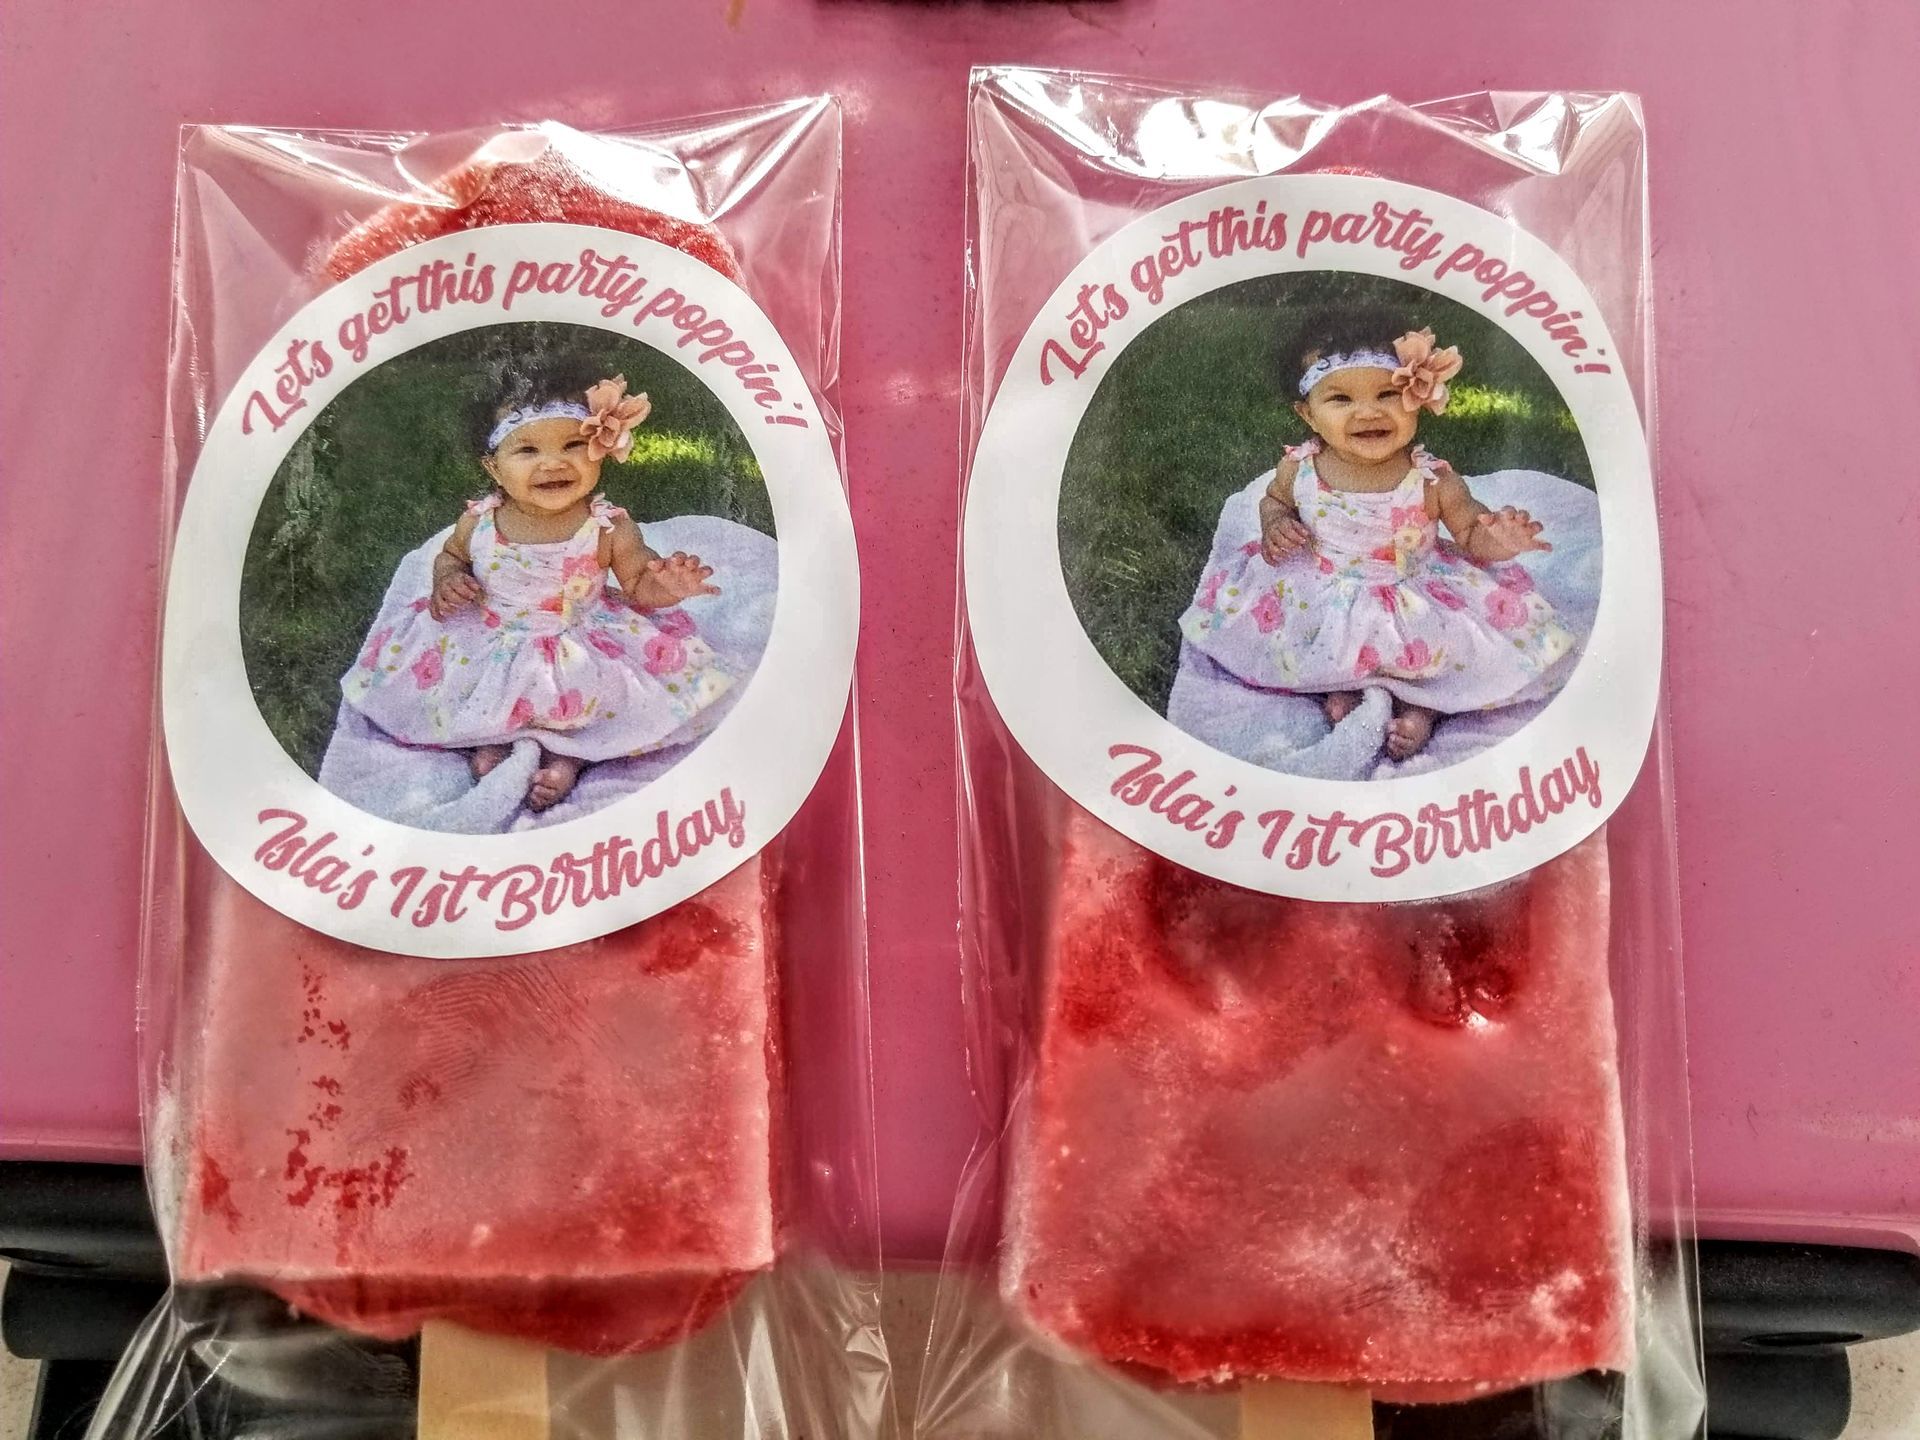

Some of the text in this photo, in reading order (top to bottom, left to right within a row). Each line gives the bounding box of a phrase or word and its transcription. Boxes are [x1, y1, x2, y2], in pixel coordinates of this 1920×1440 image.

[242, 339, 334, 435] Lets
[338, 276, 415, 363] get
[415, 252, 496, 314] this
[502, 249, 648, 318] party
[1040, 283, 1130, 386] Lets
[1130, 220, 1208, 305] get
[1207, 200, 1288, 258] this
[1296, 201, 1445, 271] party
[254, 808, 378, 911] Isla's
[477, 787, 746, 932] Birthday
[1108, 743, 1246, 849] Isla's
[1348, 745, 1603, 878] Birthday
